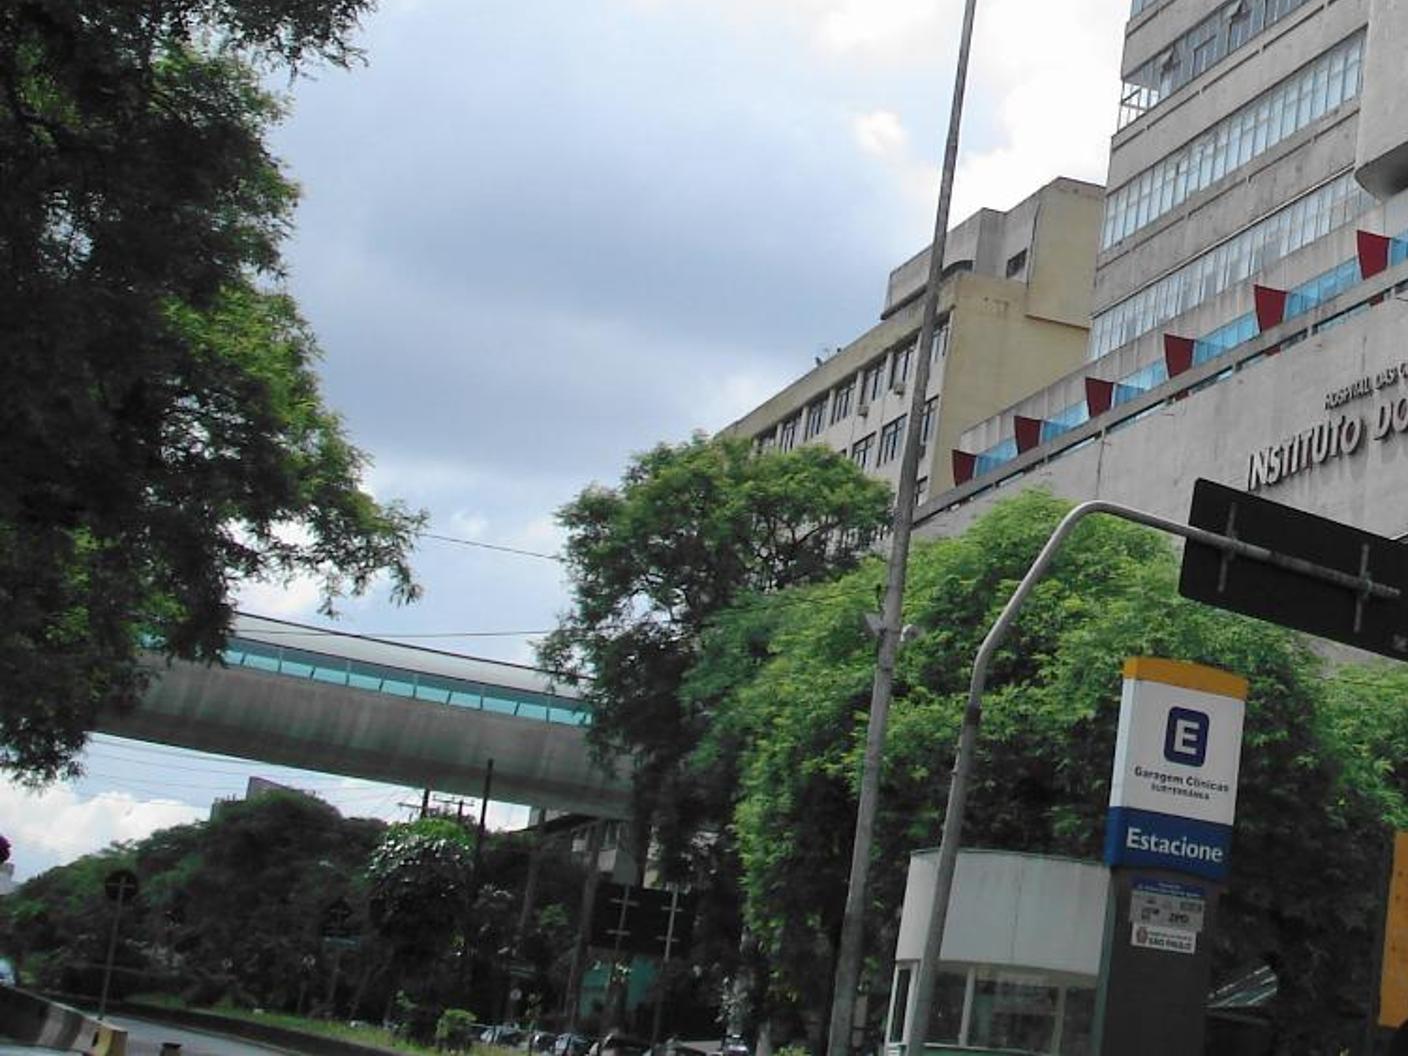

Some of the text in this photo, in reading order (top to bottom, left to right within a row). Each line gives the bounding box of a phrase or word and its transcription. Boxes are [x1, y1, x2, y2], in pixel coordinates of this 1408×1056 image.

[1325, 376, 1374, 410] HOSPITAL
[1375, 366, 1399, 390] DAS
[1248, 414, 1363, 492] INSTITUTO
[1172, 719, 1199, 755] E
[1134, 766, 1184, 785] Garagem
[1126, 826, 1223, 863] Estacione
